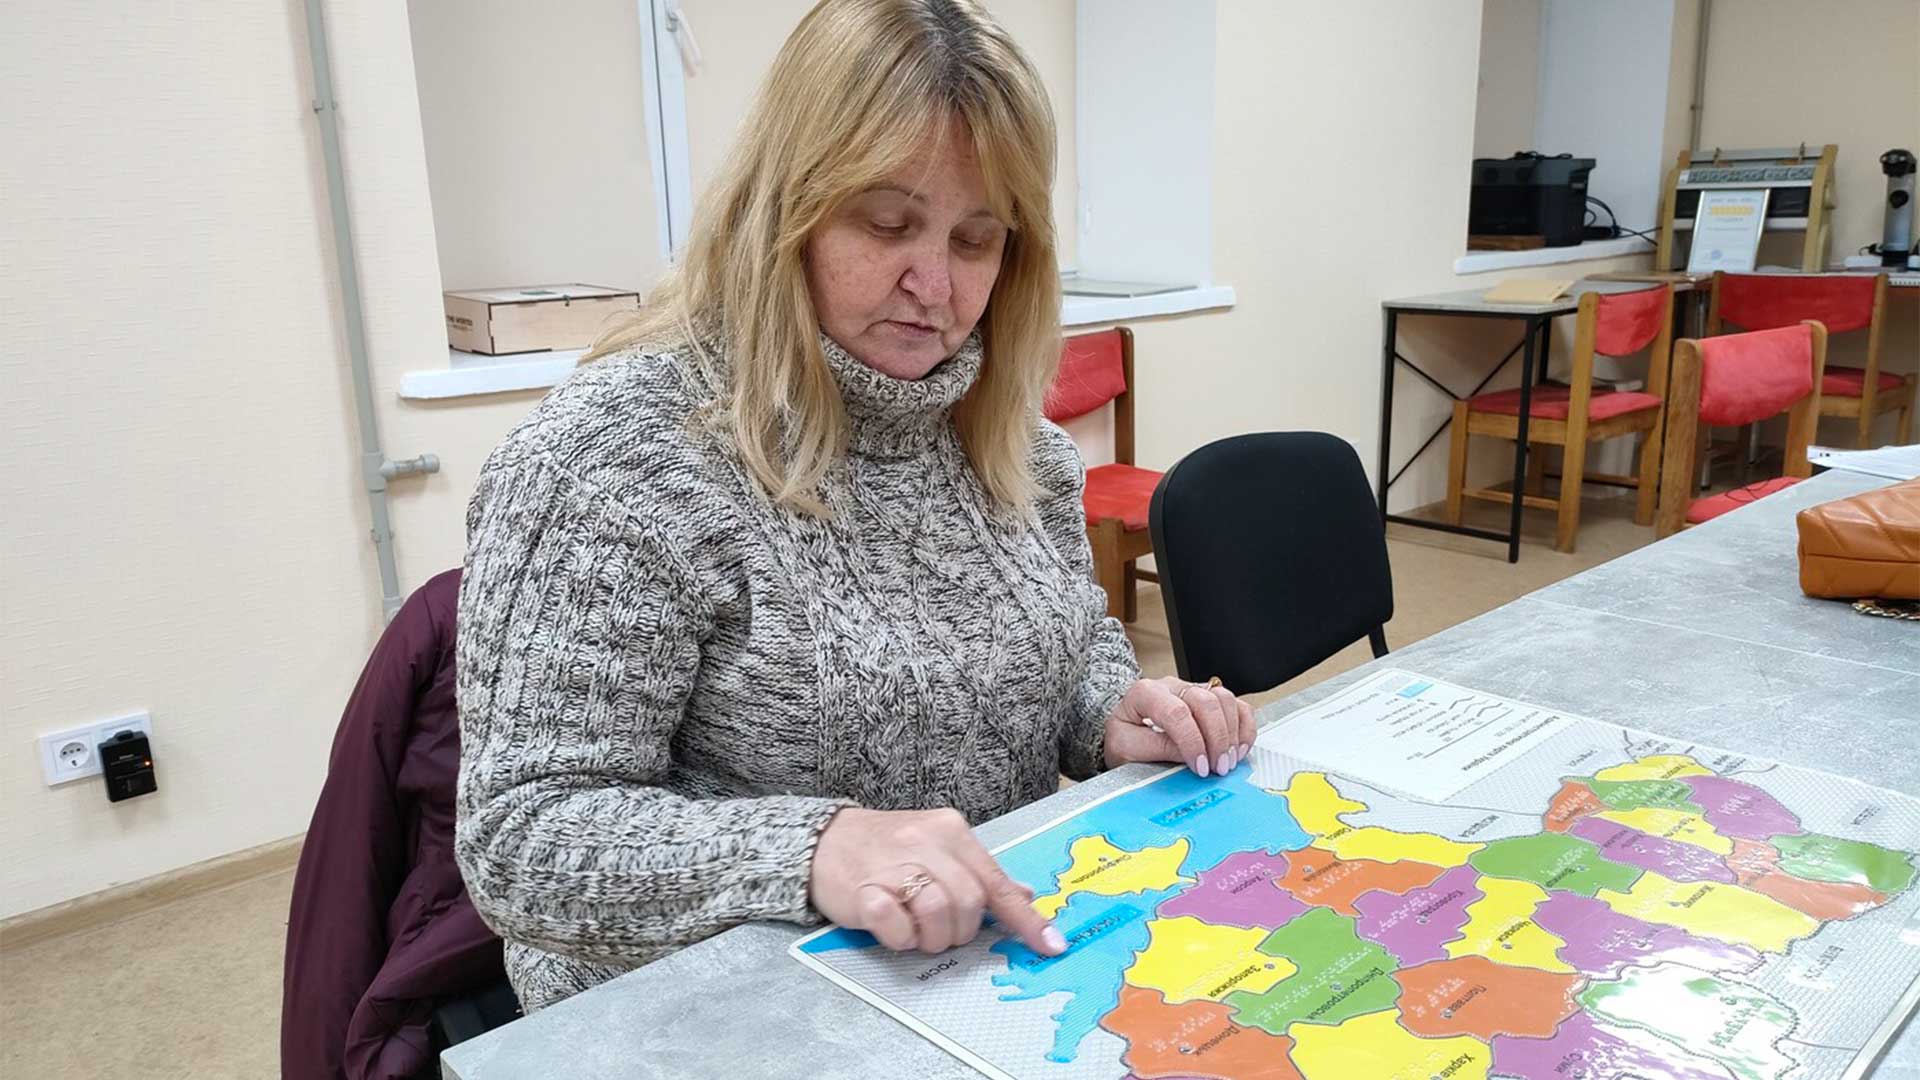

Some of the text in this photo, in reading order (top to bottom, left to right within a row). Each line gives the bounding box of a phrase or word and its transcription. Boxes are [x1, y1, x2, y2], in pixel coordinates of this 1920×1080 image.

[916, 959, 959, 982] РОСІЯ
[1207, 964, 1261, 998] Запоріжжя
[1306, 967, 1384, 1021] Дніпропетровськ
[1440, 1053, 1475, 1079] Харків
